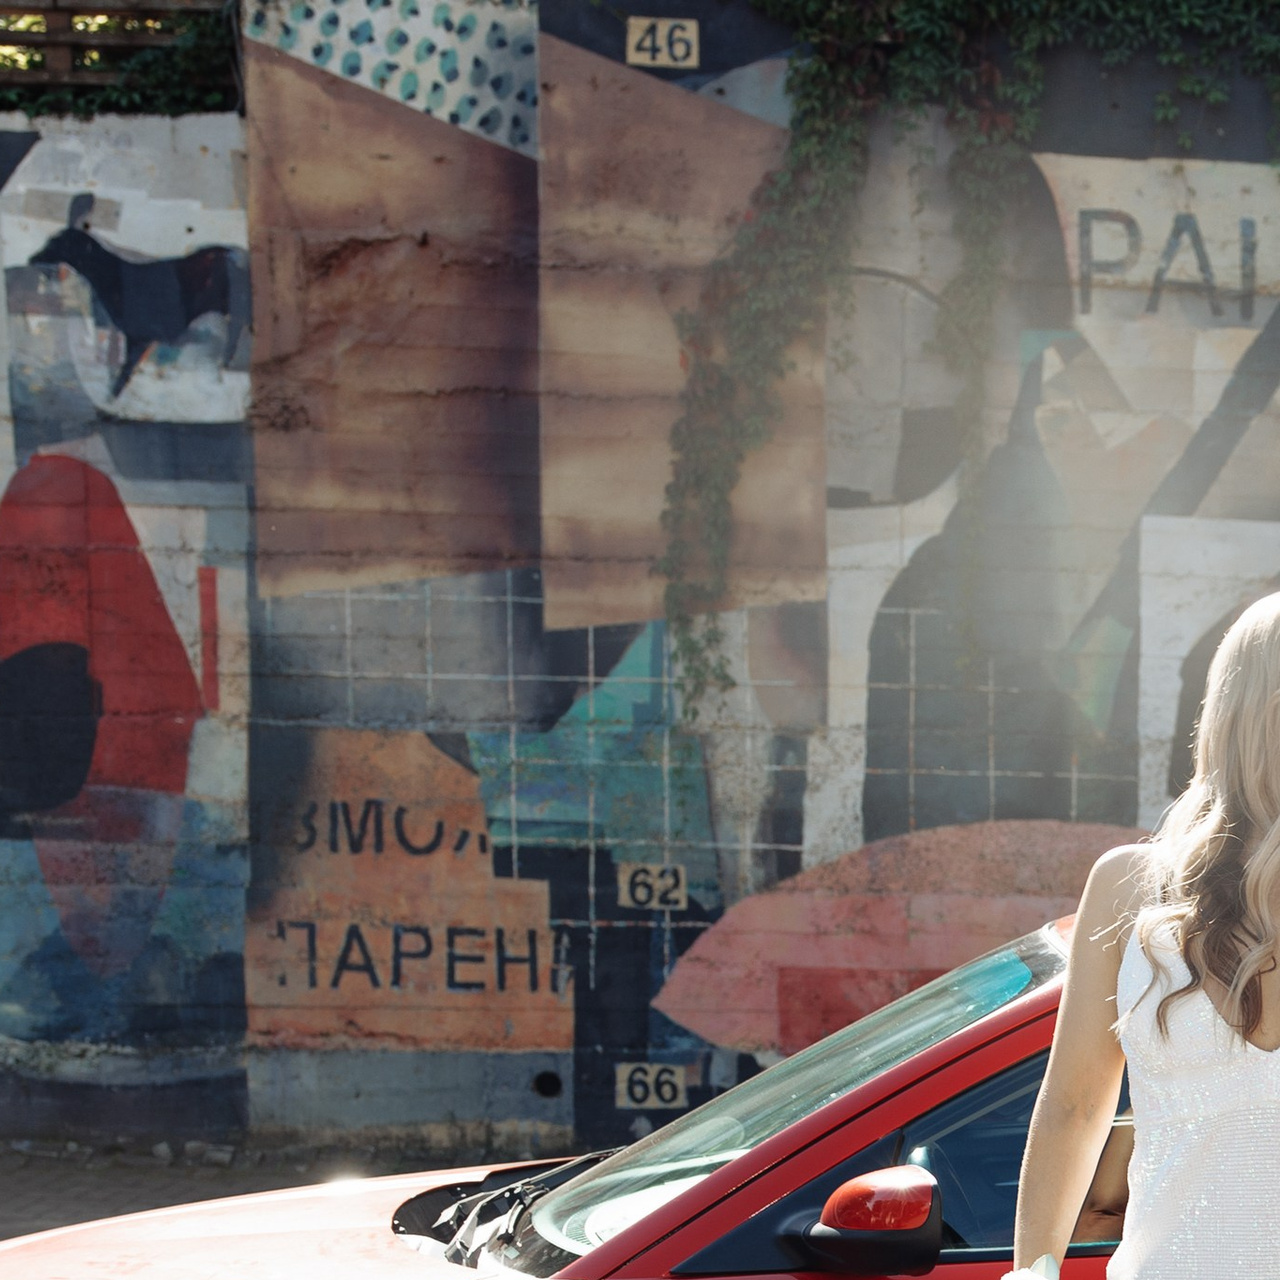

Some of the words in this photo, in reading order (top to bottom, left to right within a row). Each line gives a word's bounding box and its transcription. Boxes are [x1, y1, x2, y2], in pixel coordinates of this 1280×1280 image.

[634, 21, 692, 62] 46
[629, 867, 681, 906] 62
[627, 1066, 679, 1104] 66
